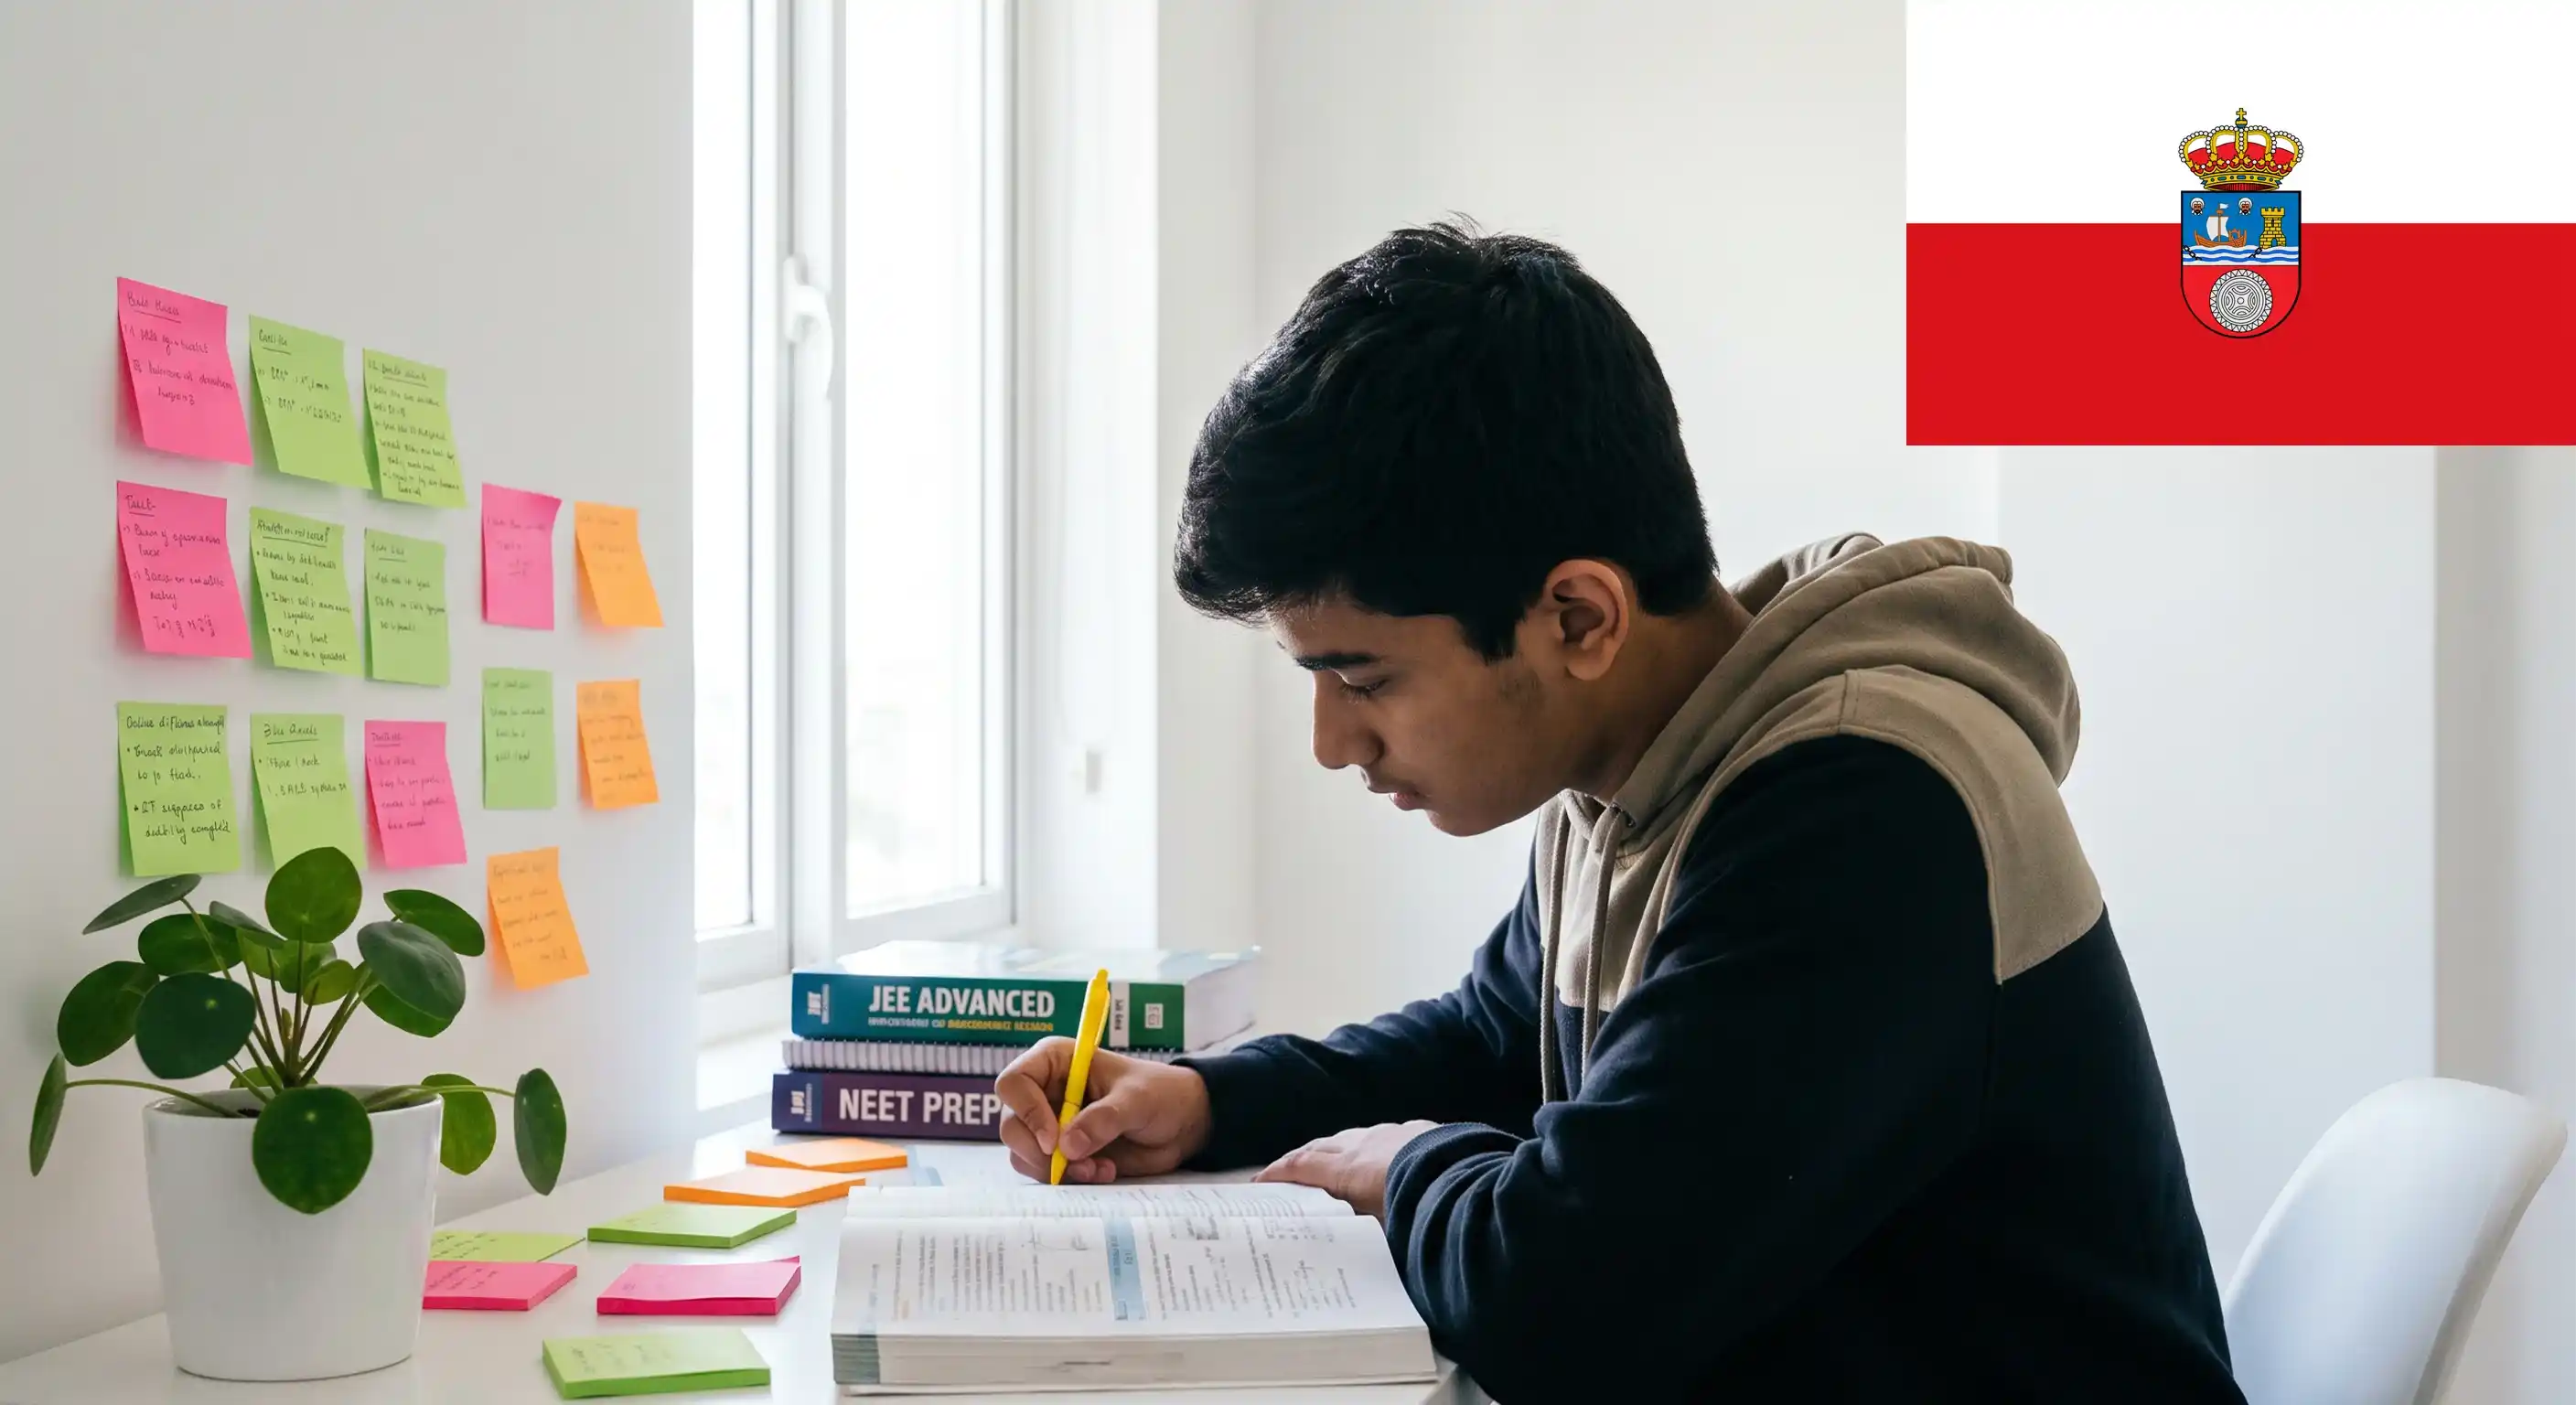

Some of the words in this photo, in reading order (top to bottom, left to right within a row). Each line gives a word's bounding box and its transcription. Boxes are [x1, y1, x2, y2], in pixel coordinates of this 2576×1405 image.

[868, 985, 911, 1013] JEE
[916, 986, 1056, 1018] ADVANCED
[839, 1088, 915, 1122] NEET
[922, 1091, 1003, 1125] PREP
